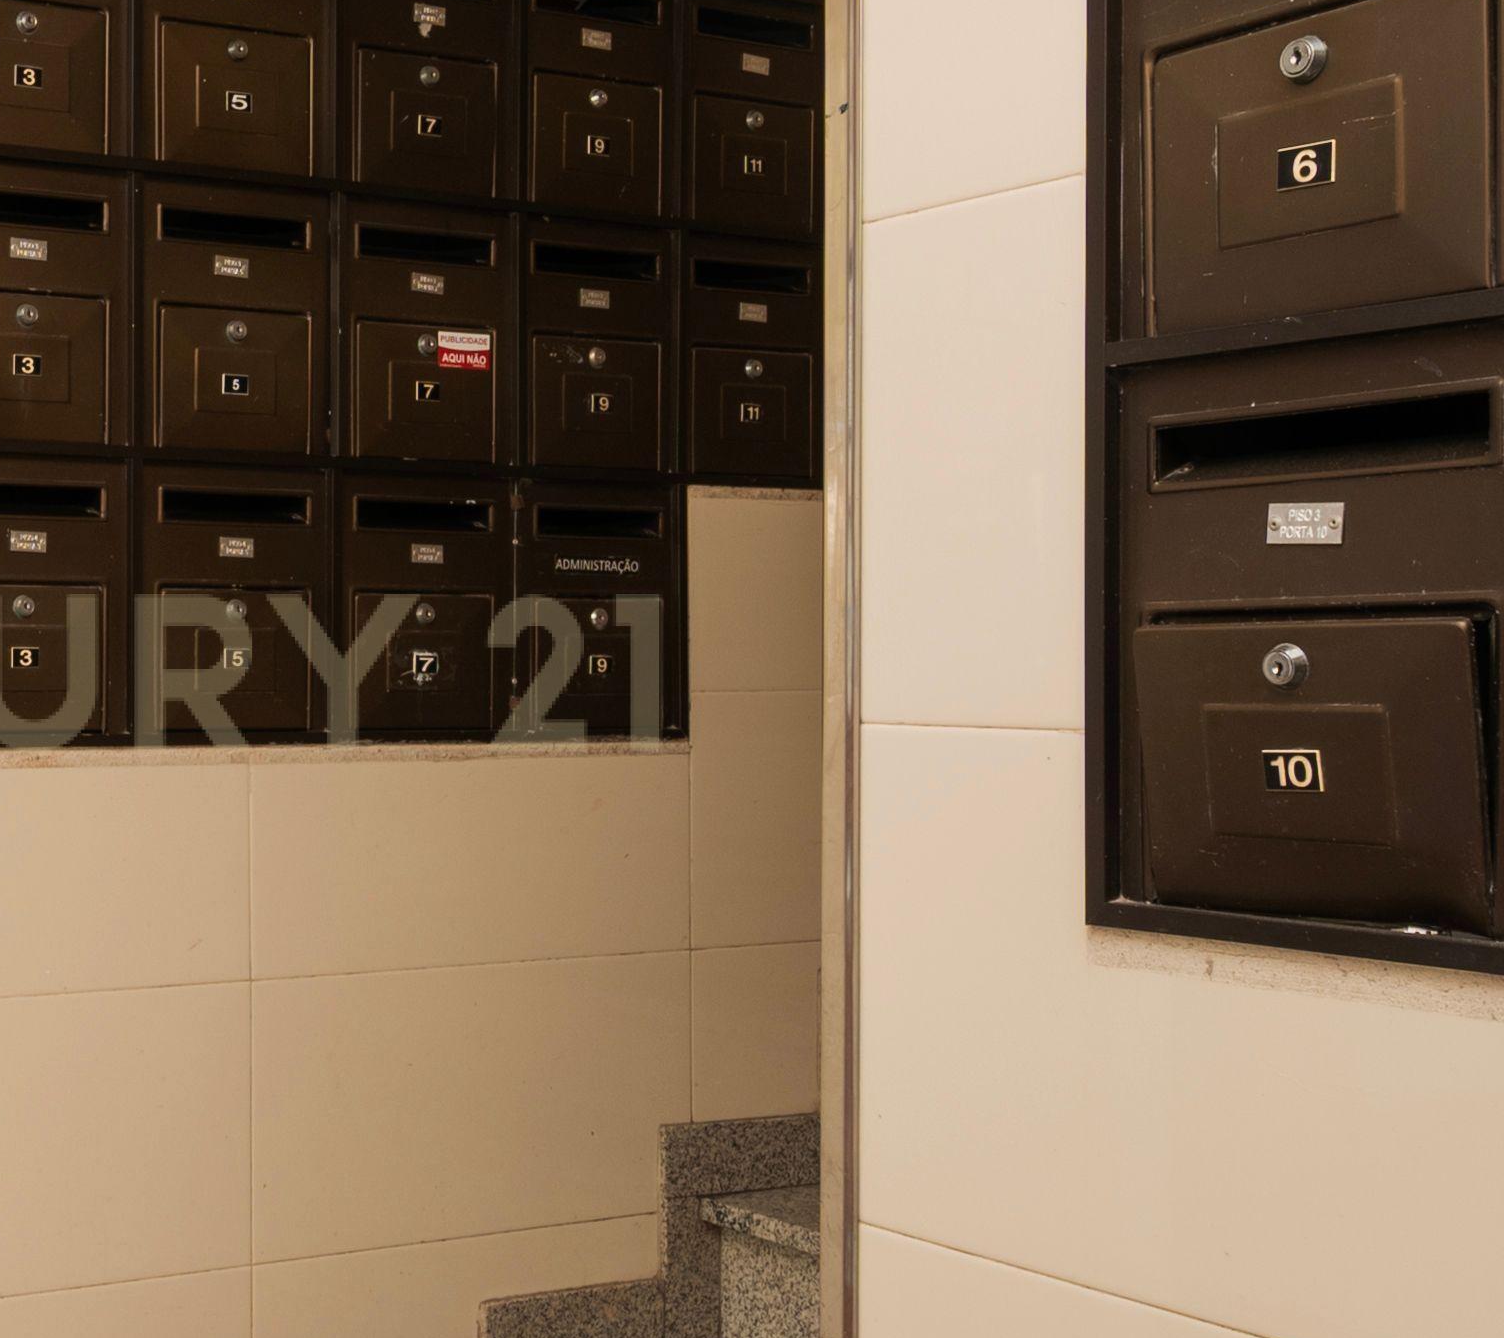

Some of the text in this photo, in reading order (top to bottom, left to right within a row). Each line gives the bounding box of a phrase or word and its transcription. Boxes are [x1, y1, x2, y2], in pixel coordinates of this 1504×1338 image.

[22, 67, 36, 86] 3
[229, 93, 249, 112] 5
[423, 117, 438, 134] 7
[593, 137, 606, 155] 9
[749, 157, 763, 174] 11
[1292, 149, 1318, 183] 6
[440, 334, 488, 346] PUBLICIDADE
[20, 355, 35, 375] 3
[442, 352, 465, 365] AQUI
[466, 353, 487, 366] NÃO
[231, 377, 240, 391] 5
[421, 382, 435, 400] 7
[598, 395, 611, 413] 9
[745, 404, 762, 420] 11
[1288, 508, 1322, 521] PISO 3
[1279, 525, 1328, 539] PORTA 10
[554, 557, 639, 575] ADMINISTRAÇÃO
[18, 648, 34, 666] 3
[232, 649, 244, 668] 5
[417, 656, 435, 674] 7
[596, 657, 608, 674] 9
[1269, 755, 1313, 788] 10
